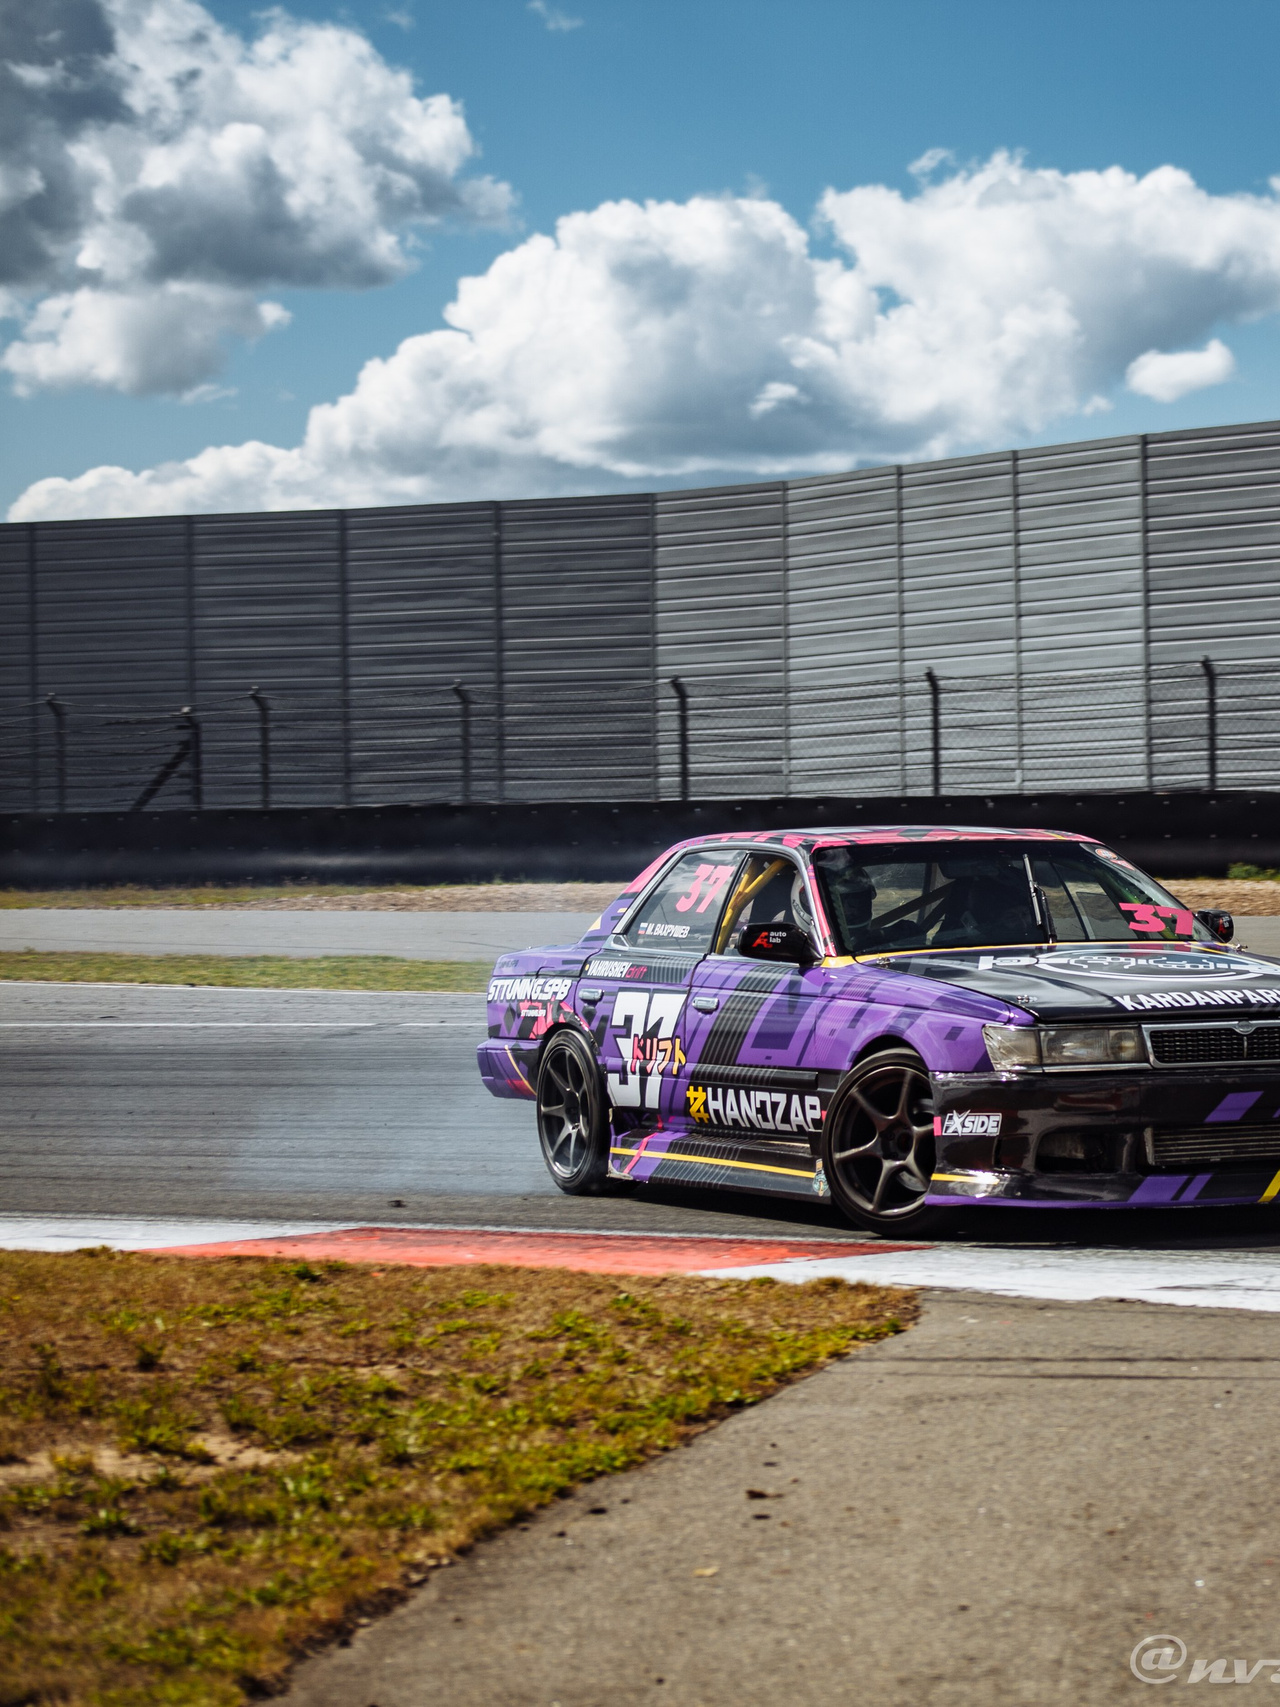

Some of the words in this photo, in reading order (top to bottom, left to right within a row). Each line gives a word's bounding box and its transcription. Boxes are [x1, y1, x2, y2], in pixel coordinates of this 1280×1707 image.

[676, 864, 735, 913] 37
[1118, 902, 1194, 936] 37
[607, 991, 688, 1109] 37
[631, 1033, 686, 1075] ドリフト
